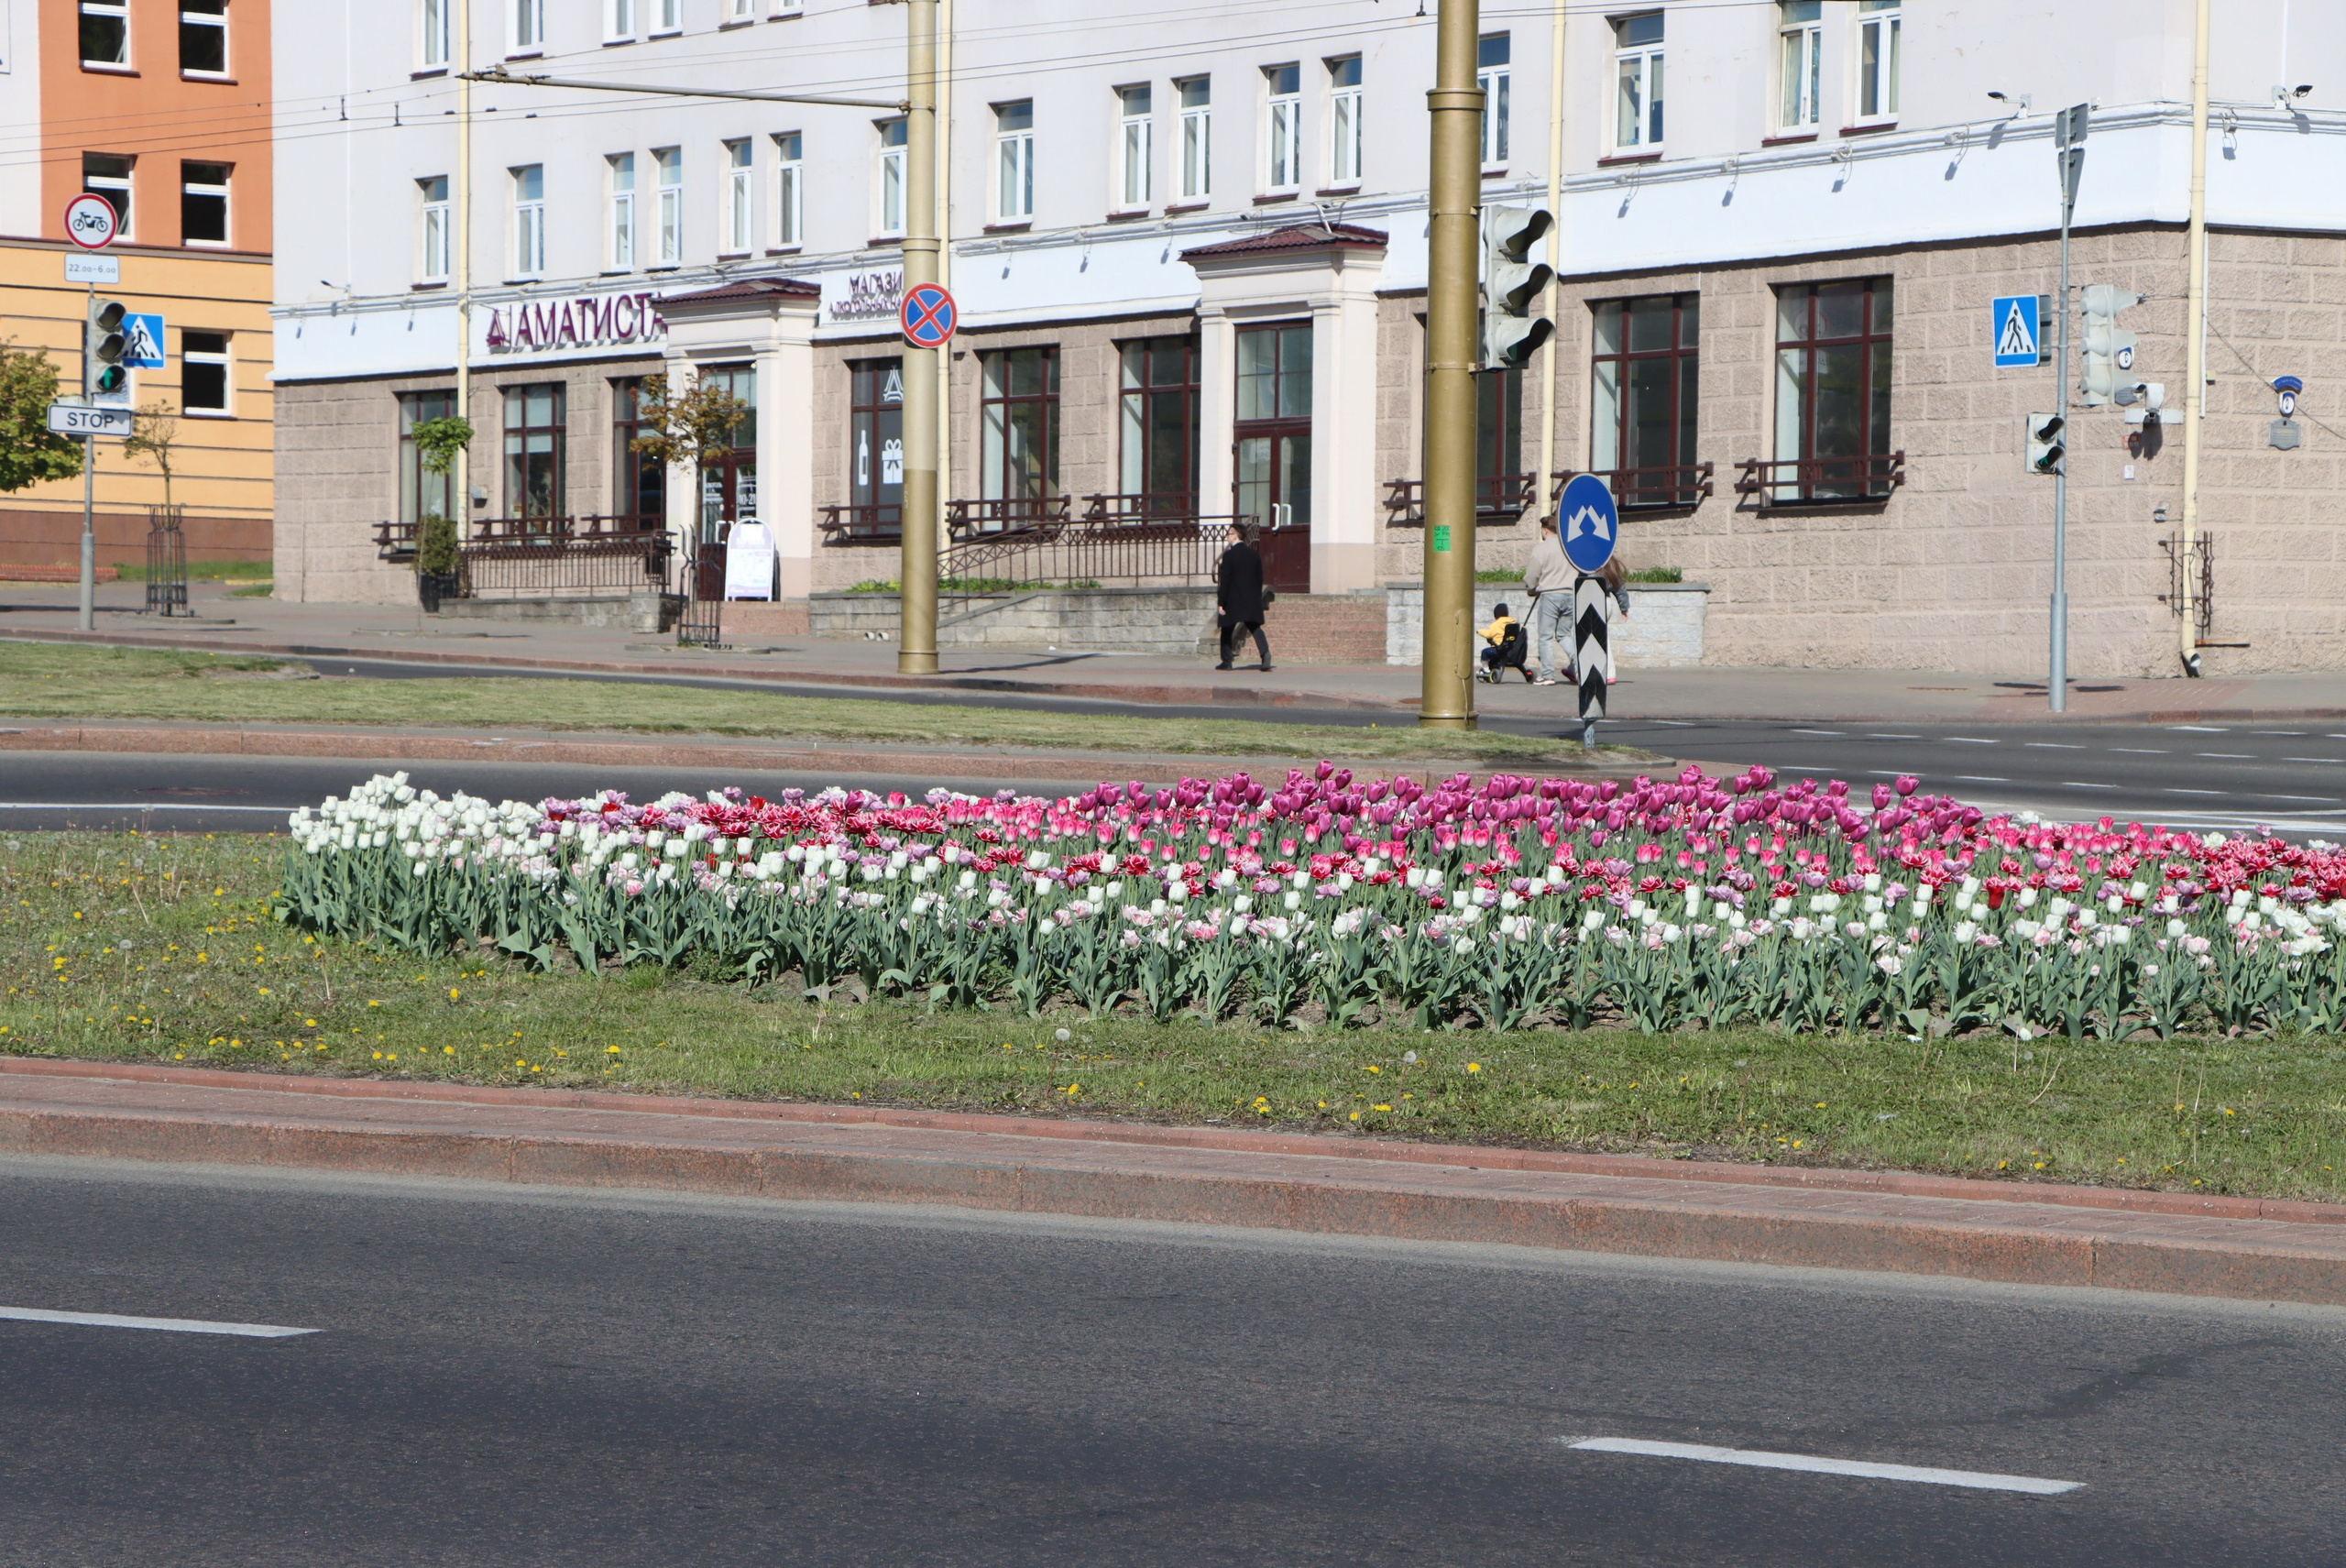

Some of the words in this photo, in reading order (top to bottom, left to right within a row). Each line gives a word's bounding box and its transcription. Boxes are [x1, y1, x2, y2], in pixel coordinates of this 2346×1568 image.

[849, 271, 903, 295] МАГАЗИ
[891, 295, 903, 311] НА
[67, 411, 115, 429] STOP
